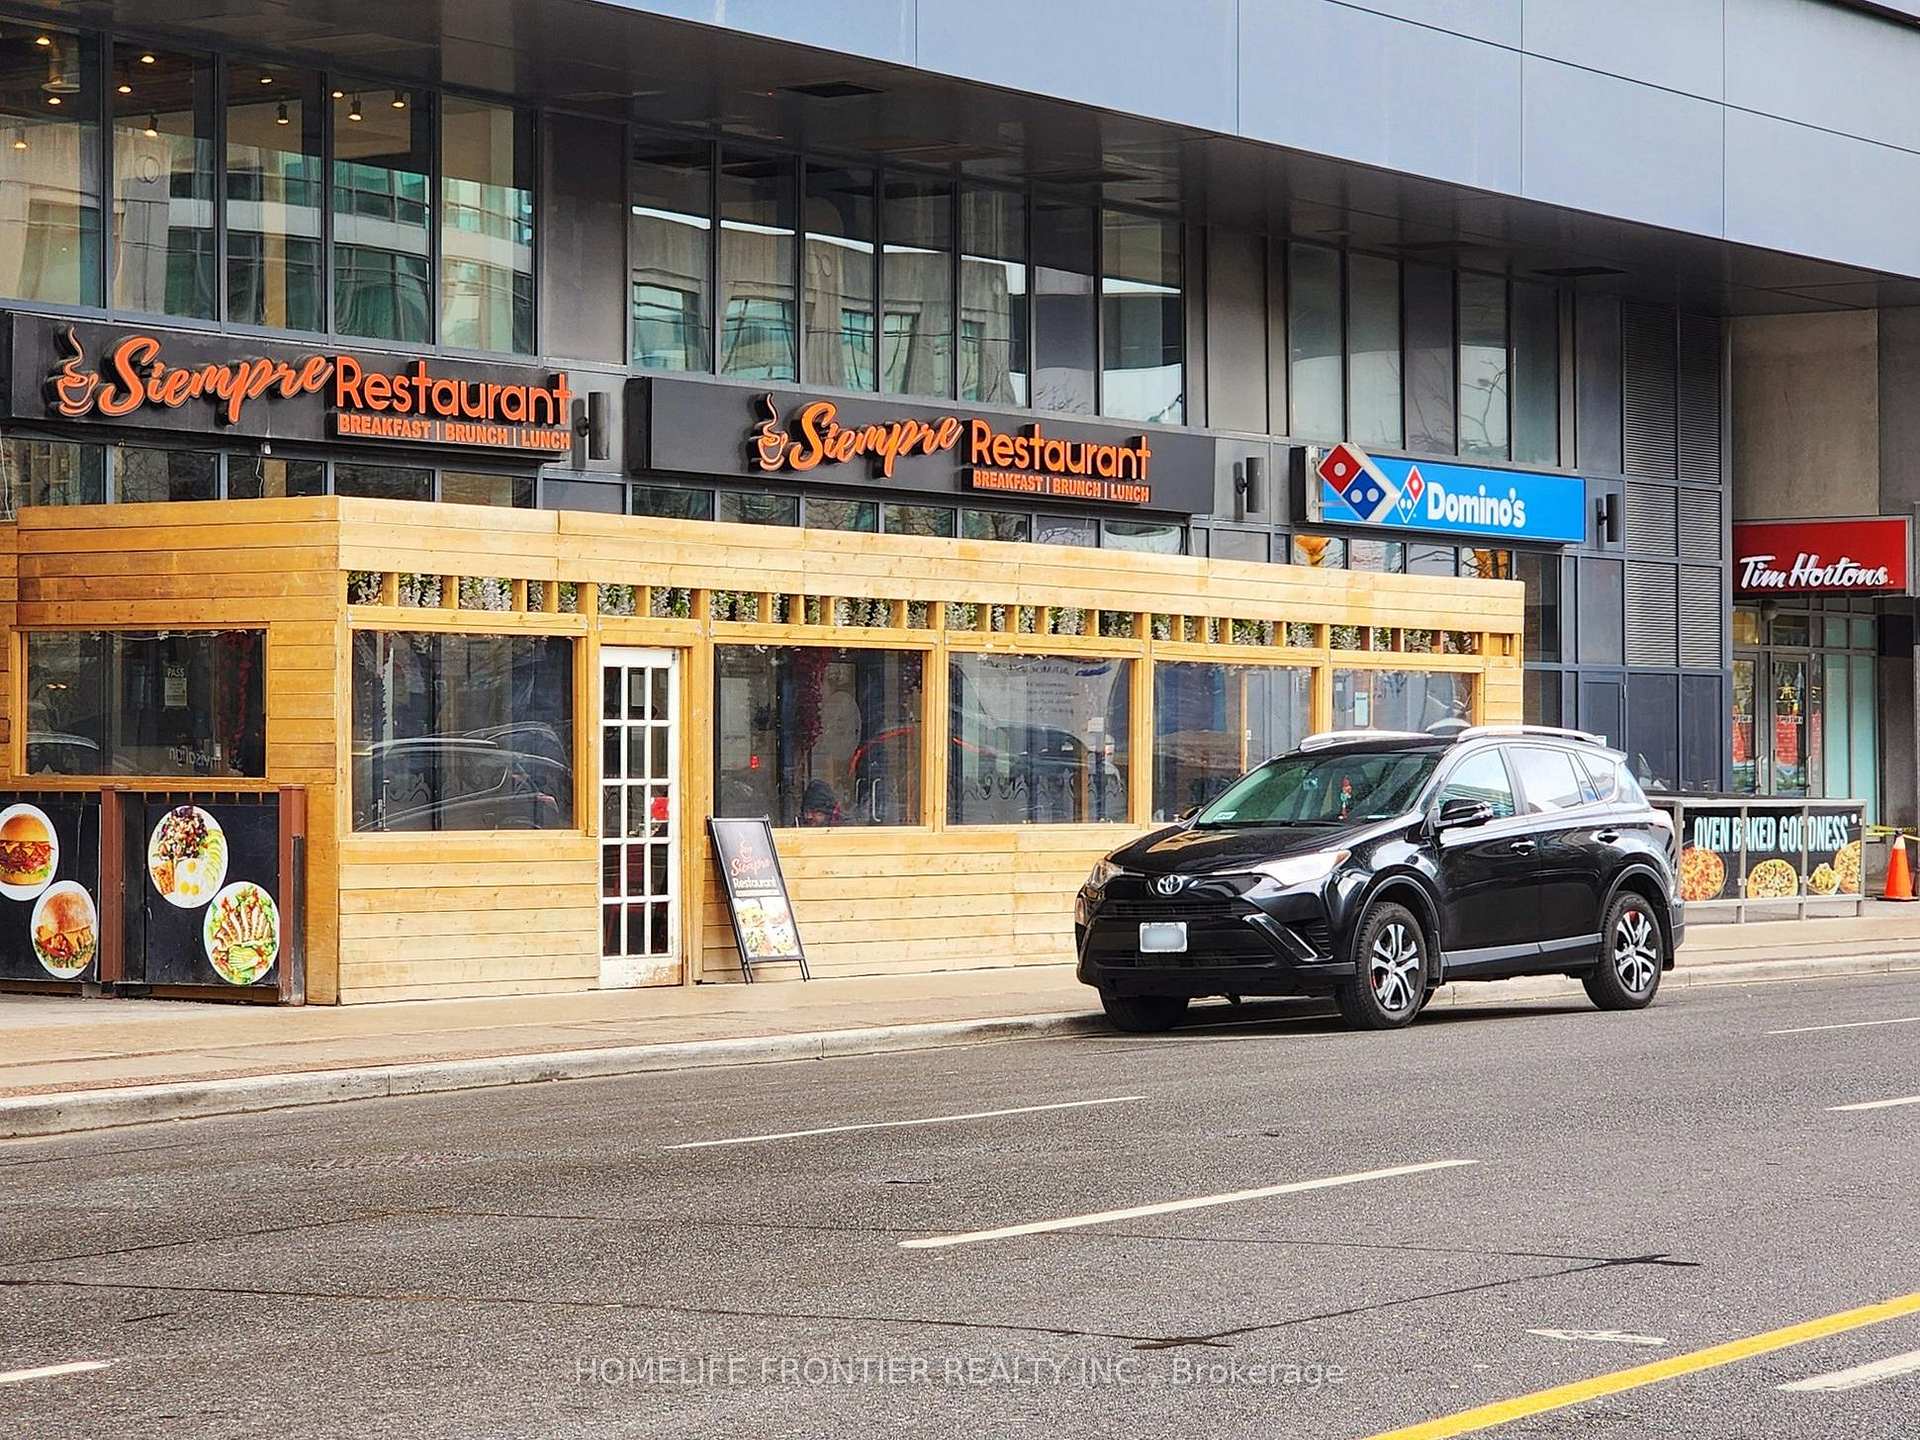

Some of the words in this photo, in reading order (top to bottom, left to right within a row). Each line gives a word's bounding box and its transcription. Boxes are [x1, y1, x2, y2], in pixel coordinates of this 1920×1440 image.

[98, 336, 334, 425] Siempre
[337, 355, 571, 425] Restaurant
[338, 413, 431, 439] BREAKFAST
[445, 422, 508, 445] BRUNCH
[521, 428, 570, 450] LUNCH
[790, 401, 963, 479] Siempre
[971, 417, 1151, 480] Restaurant
[973, 469, 1043, 492] BREAKFAST
[1052, 477, 1101, 498] BRUNCH
[1110, 483, 1149, 502] LUNCH
[1427, 482, 1526, 528] Domino's
[1739, 555, 1788, 589] Tim
[1788, 553, 1889, 588] Hortons
[167, 668, 185, 678] PASS
[1694, 815, 1730, 852] OVEN
[1732, 816, 1777, 852] BAKED
[732, 876, 777, 888] Restaurant
